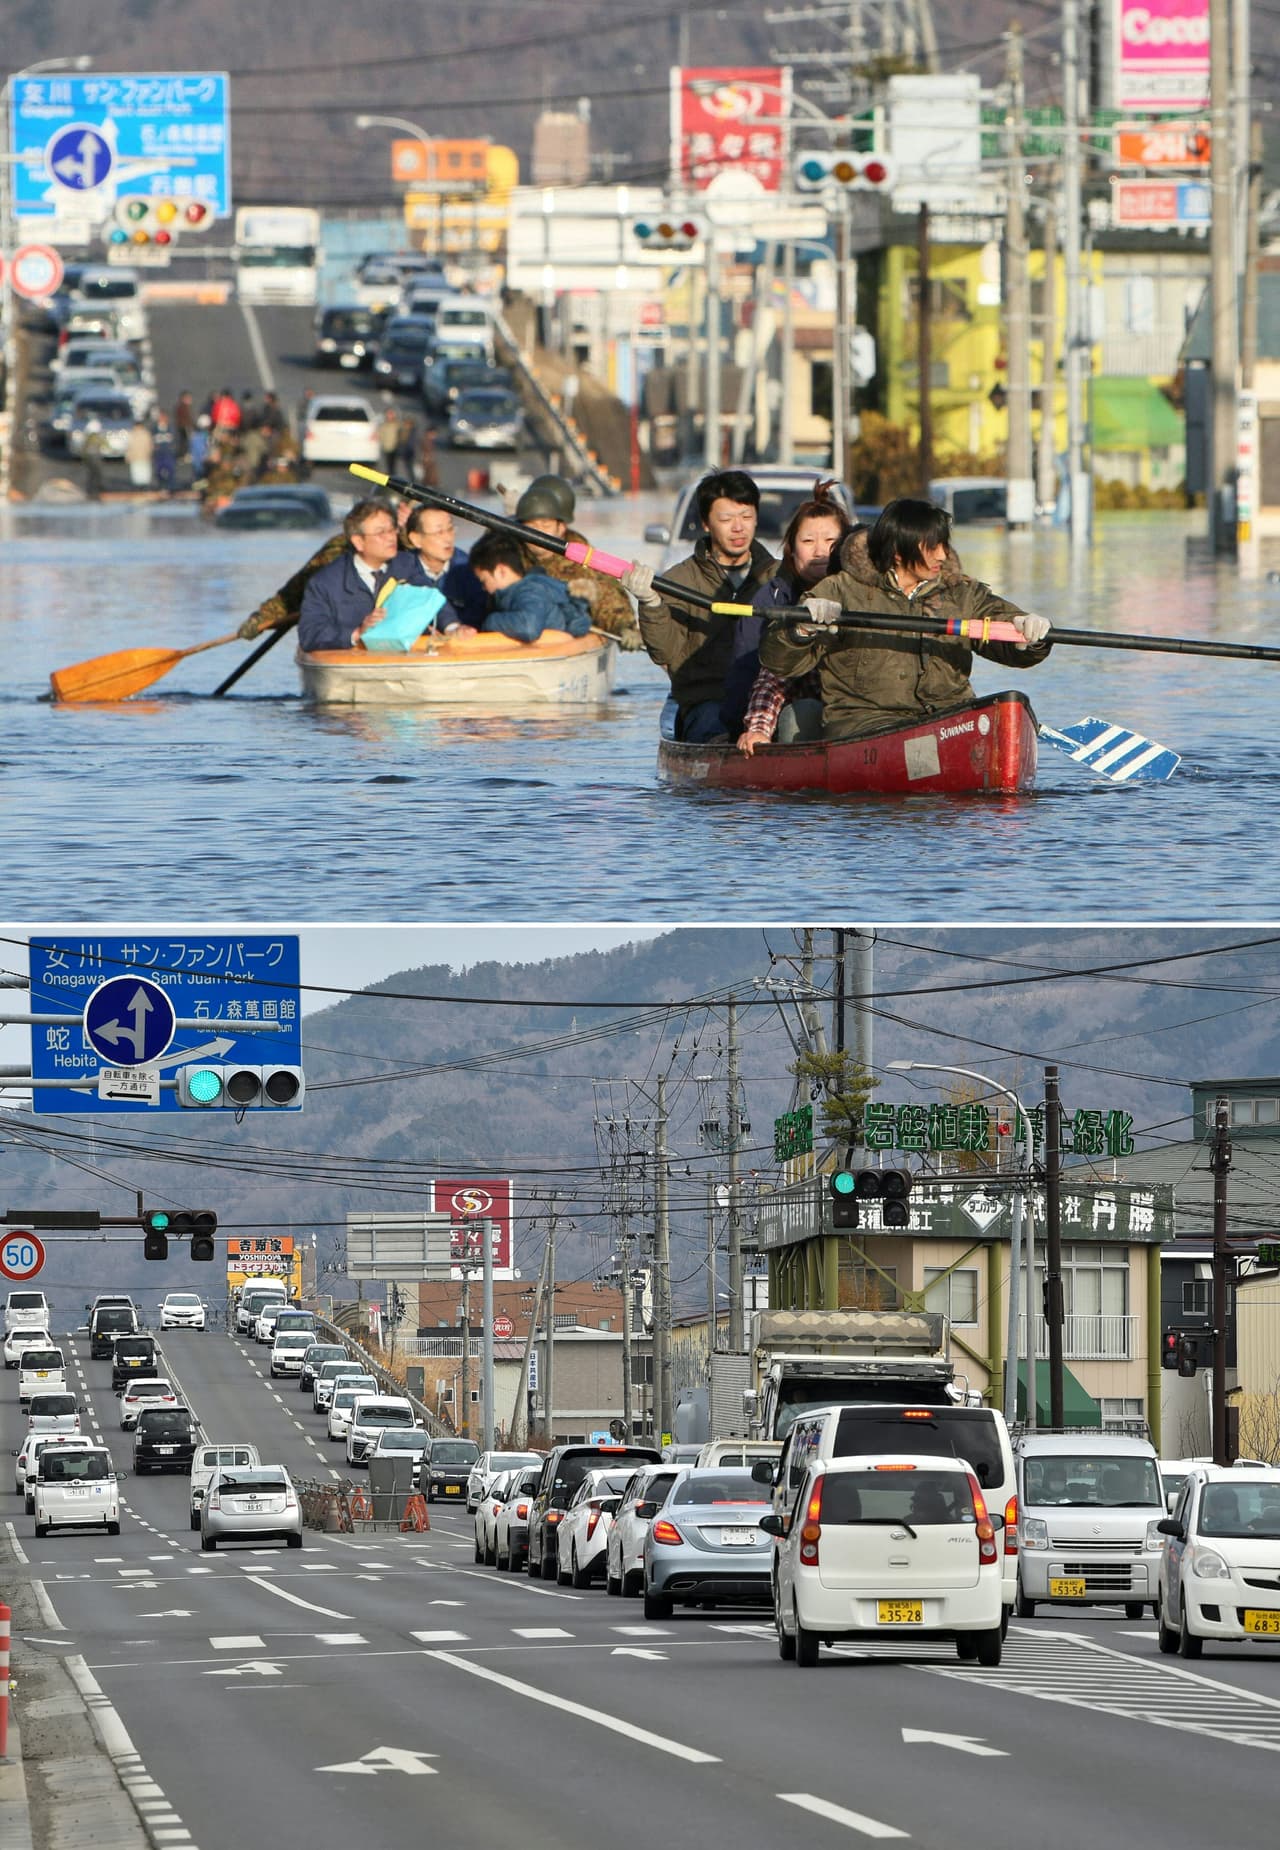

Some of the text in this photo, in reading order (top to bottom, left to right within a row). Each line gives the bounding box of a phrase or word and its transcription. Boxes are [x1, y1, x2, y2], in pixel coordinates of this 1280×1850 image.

[939, 720, 975, 741] SUWANNEE
[45, 942, 285, 969] 女川 サン・ファンパーク
[43, 971, 255, 987] Onagawa Sant Juan Park
[193, 999, 296, 1020] 石ノ森萬画館
[54, 1053, 97, 1067] Hebita
[104, 1070, 154, 1082] 自転車を除く
[110, 1082, 147, 1092] 一方通行
[865, 1102, 990, 1152] 岩盤植栽
[6, 1244, 34, 1267] 50
[529, 1353, 537, 1389] 日本共産党
[1057, 1585, 1083, 1595] 53-54
[887, 1610, 922, 1622] 35-28
[1254, 1620, 1280, 1632] 68-3
